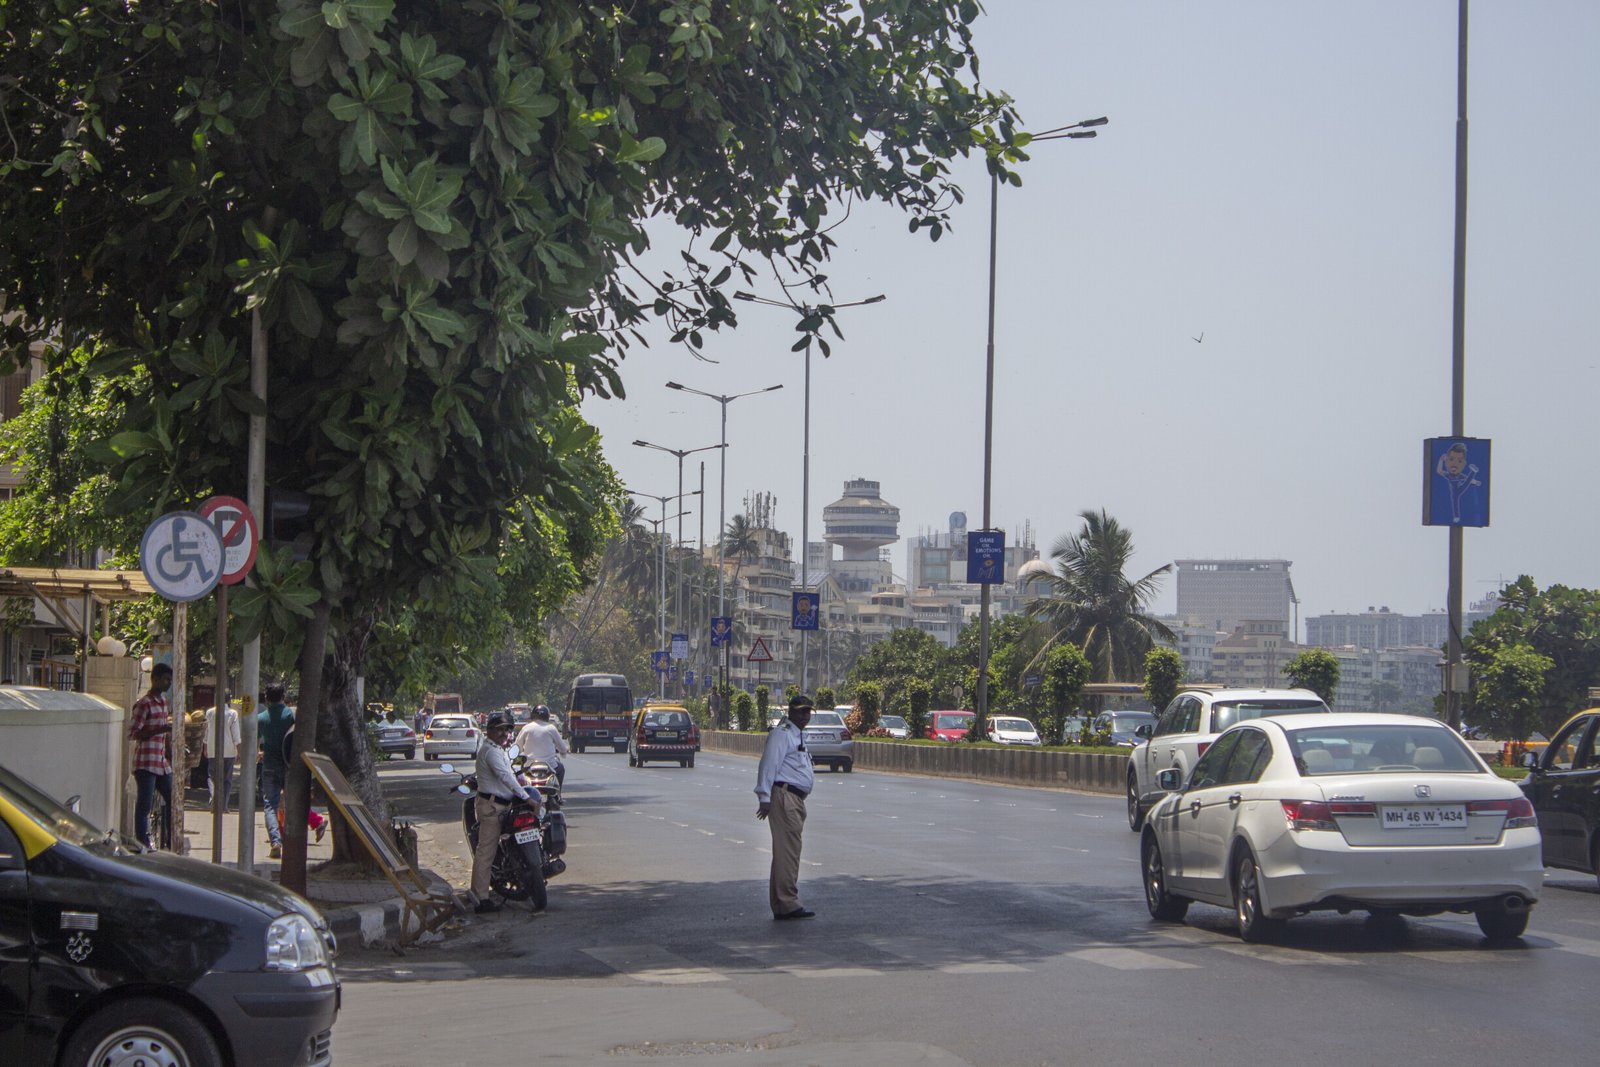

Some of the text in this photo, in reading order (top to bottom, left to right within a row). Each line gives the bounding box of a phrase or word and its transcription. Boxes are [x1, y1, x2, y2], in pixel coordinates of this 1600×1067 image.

[1386, 811, 1463, 822] MH 46 W 1434
